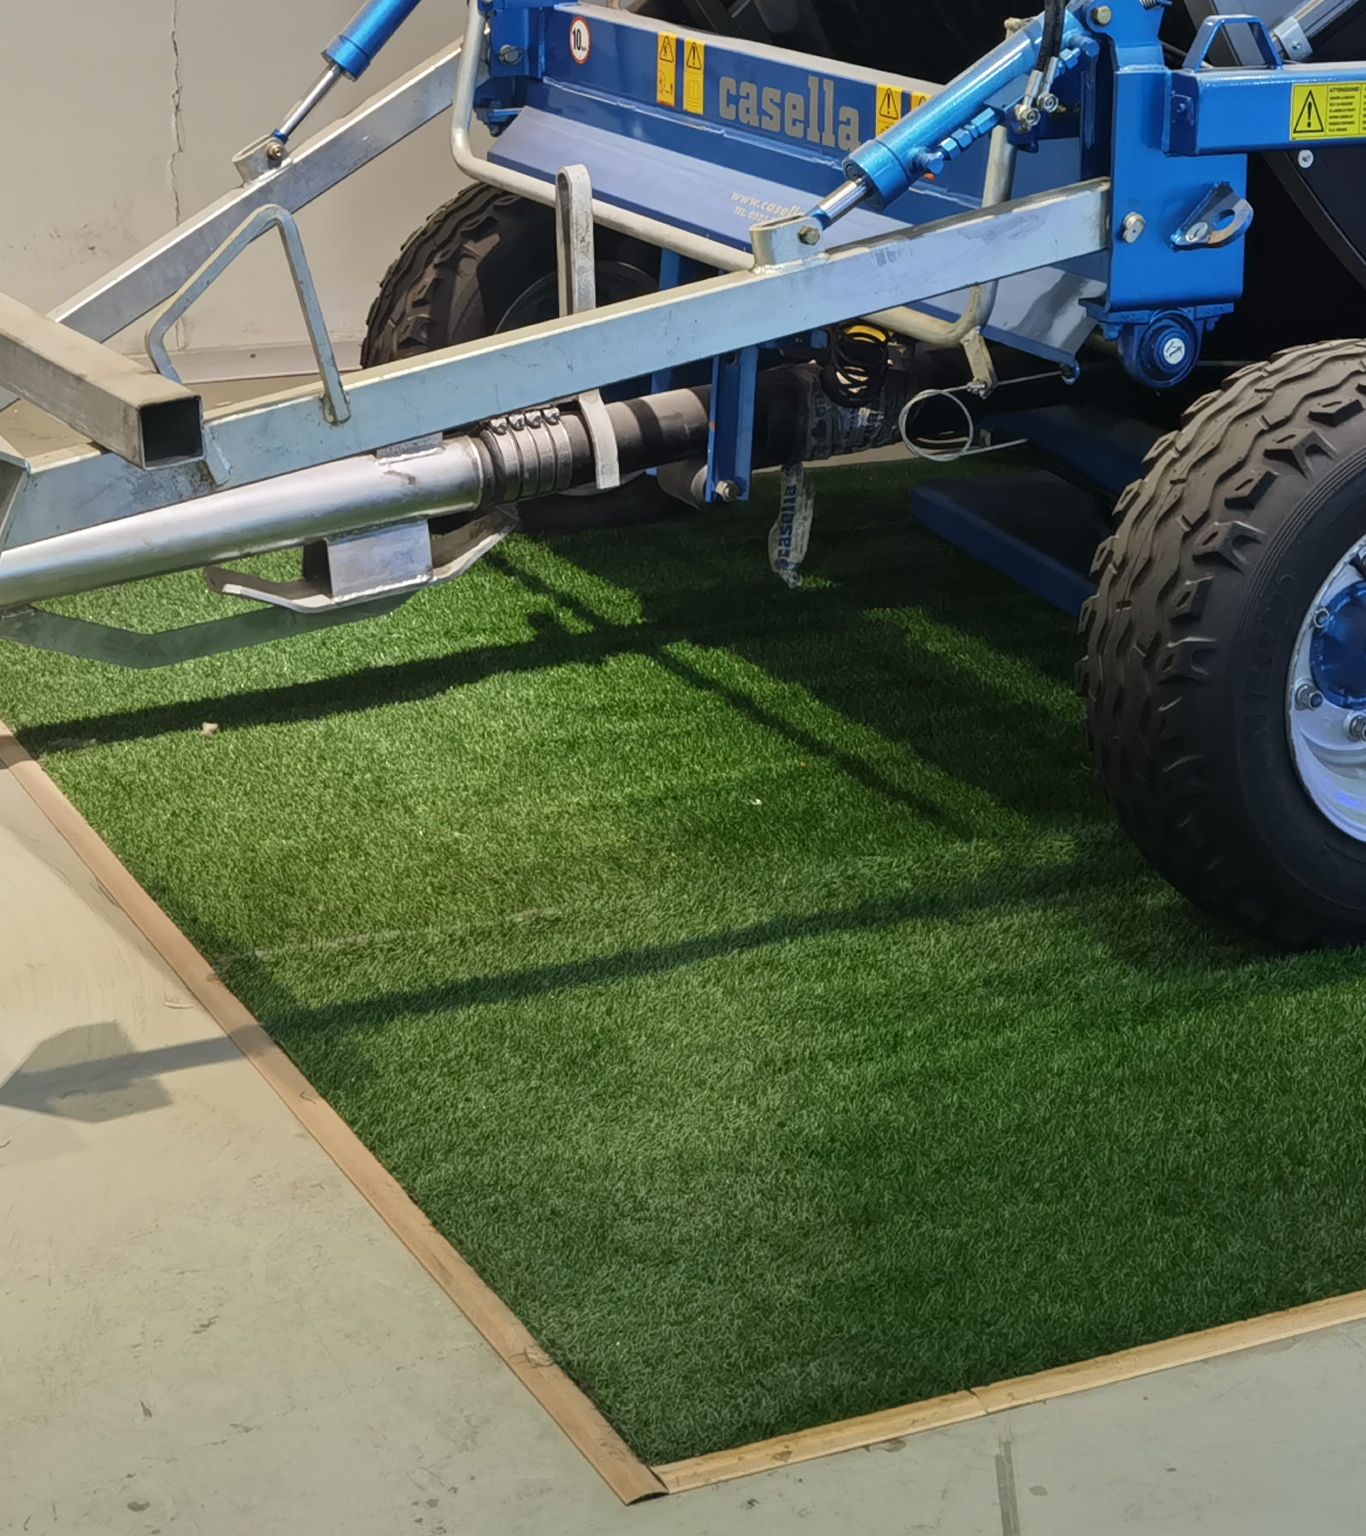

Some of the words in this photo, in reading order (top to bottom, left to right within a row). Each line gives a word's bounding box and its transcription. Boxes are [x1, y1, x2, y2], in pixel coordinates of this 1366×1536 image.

[572, 28, 582, 51] 10
[719, 75, 861, 151] casella
[730, 192, 804, 217] www.casell
[777, 484, 798, 558] casella
